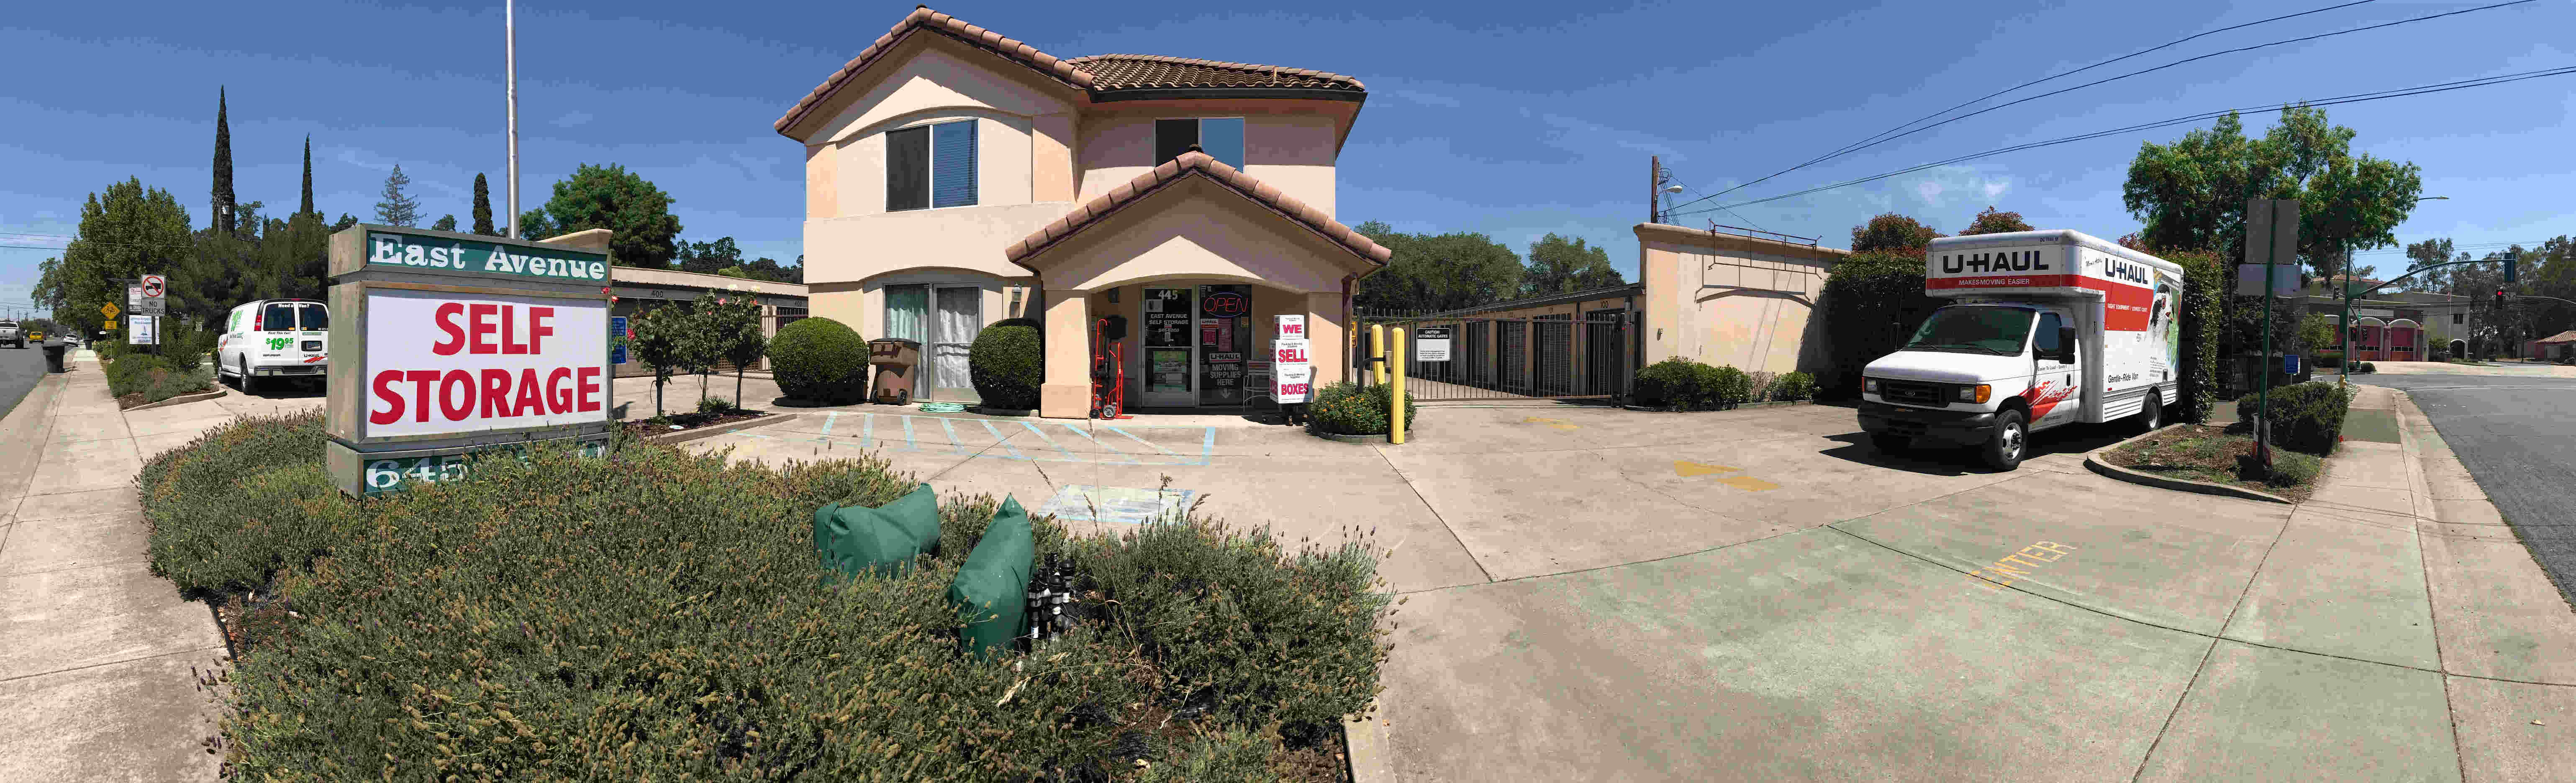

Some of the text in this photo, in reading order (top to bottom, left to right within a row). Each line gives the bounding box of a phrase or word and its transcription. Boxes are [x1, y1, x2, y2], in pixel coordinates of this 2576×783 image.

[370, 233, 605, 280] East Avenue
[1158, 289, 1178, 300] 445
[1203, 297, 1248, 312] OPEN
[432, 302, 554, 356] SELF
[1283, 324, 1302, 334] WE
[1278, 349, 1308, 363] SELL
[369, 366, 600, 425] STORAGE
[1281, 383, 1309, 395] BOXES
